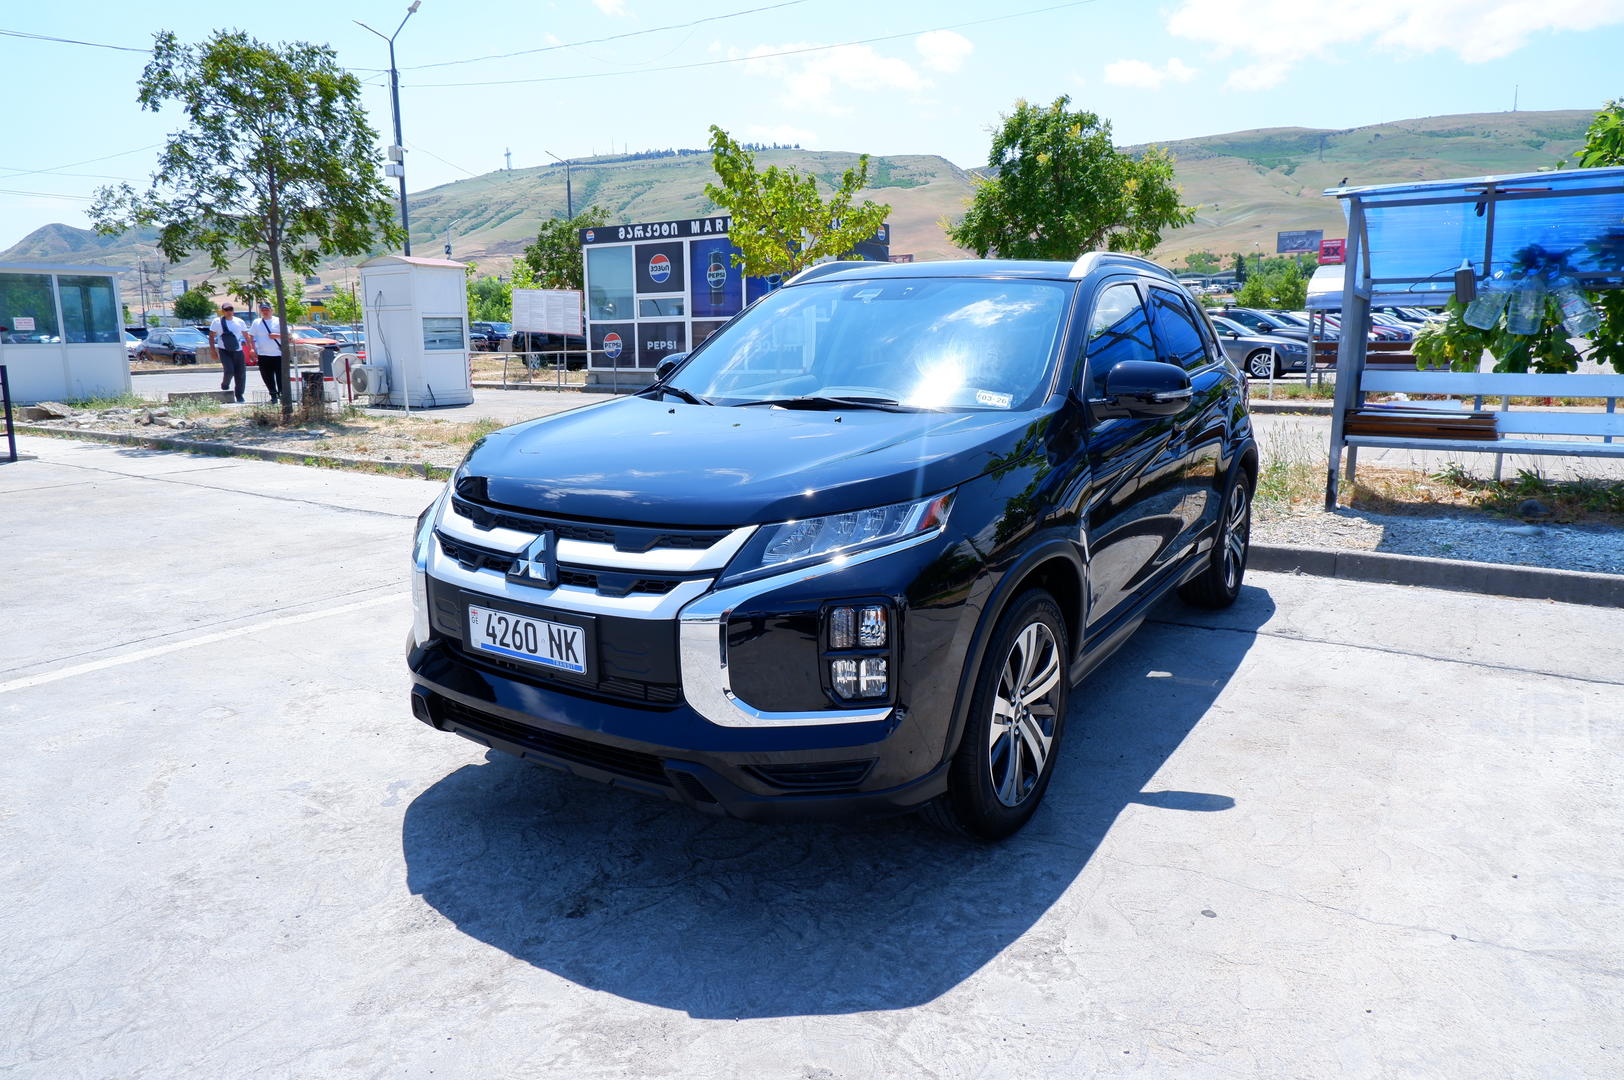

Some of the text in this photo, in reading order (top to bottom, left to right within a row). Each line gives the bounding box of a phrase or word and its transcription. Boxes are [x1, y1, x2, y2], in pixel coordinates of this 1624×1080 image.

[619, 223, 678, 239] მარკეტი
[691, 218, 737, 234] MARK
[445, 244, 452, 255] 2
[647, 340, 677, 350] PEPSI
[485, 613, 579, 663] 4260 NK
